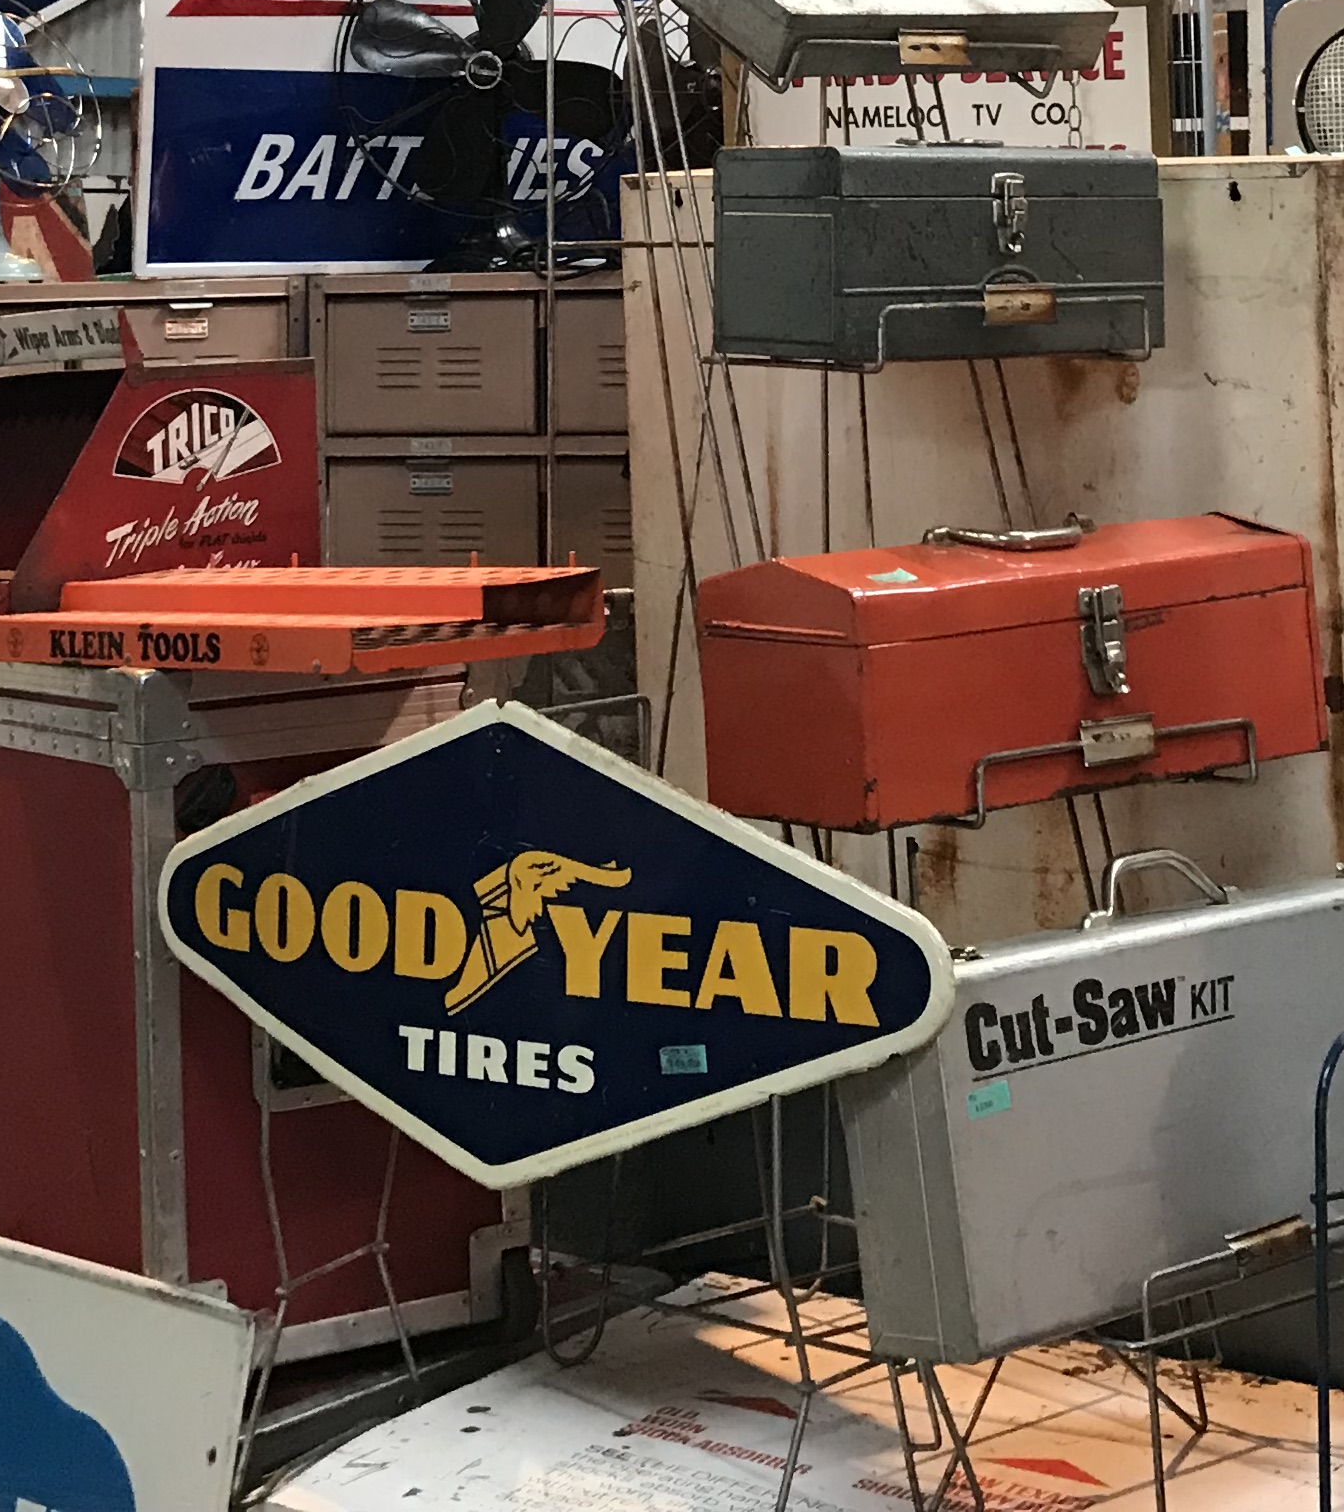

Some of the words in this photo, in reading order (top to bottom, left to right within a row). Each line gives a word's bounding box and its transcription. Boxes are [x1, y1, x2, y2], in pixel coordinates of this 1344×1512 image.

[971, 103, 1002, 126] TV
[235, 134, 604, 202] BATTIES
[146, 402, 235, 474] TRICO
[105, 506, 179, 568] Triple
[183, 492, 259, 536] Action
[49, 630, 125, 661] KLEIN
[138, 627, 222, 664] TOOLS
[194, 862, 468, 980] GOOD
[549, 905, 880, 1028] YEAR
[965, 978, 1176, 1072] Cut-Saw
[1190, 974, 1235, 1021] KIT
[398, 1024, 596, 1094] TIRES
[691, 1440, 813, 1475] ABSORBR
